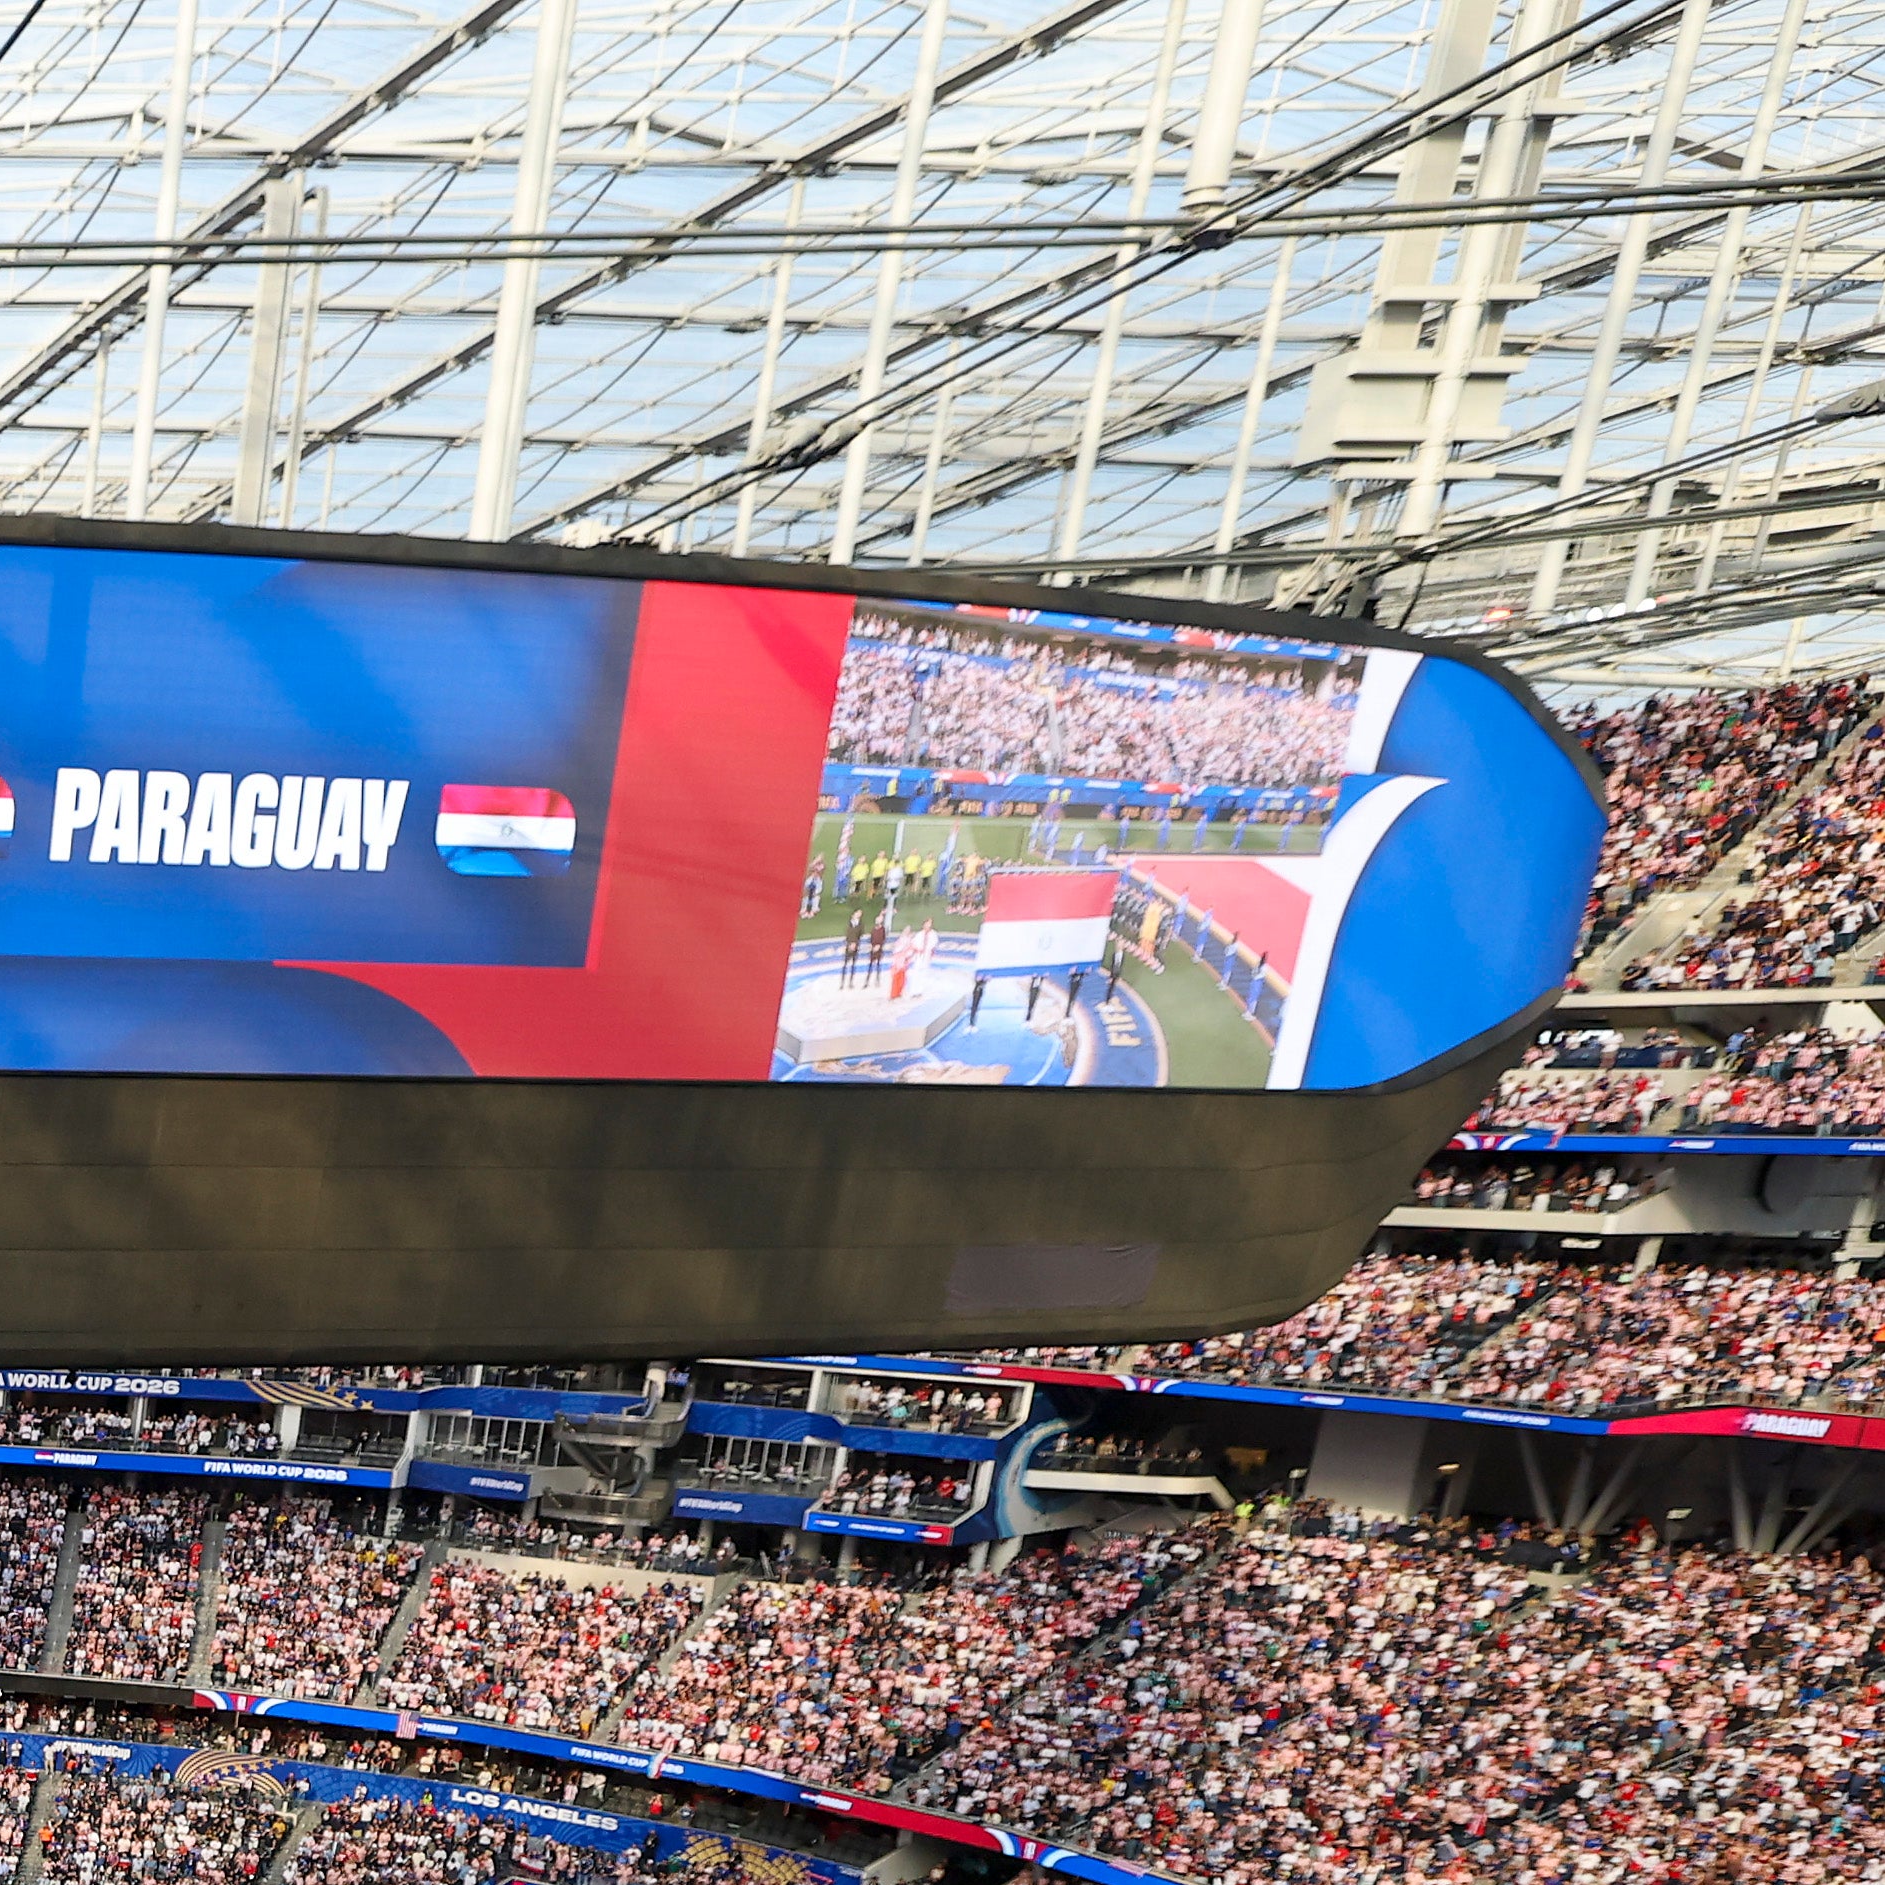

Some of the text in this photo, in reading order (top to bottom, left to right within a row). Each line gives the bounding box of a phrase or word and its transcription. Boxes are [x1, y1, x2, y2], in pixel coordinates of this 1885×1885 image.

[49, 768, 411, 872] PARAGUAY
[76, 1376, 113, 1391] CUP
[115, 1380, 181, 1396] 2026
[54, 1452, 98, 1466] PARAGUAY
[204, 1461, 348, 1482] FIFA WORLD CUP 2026
[571, 1746, 593, 1757] FIFA
[593, 1749, 629, 1763] WORLD
[451, 1788, 619, 1832] LOS ANGELES
